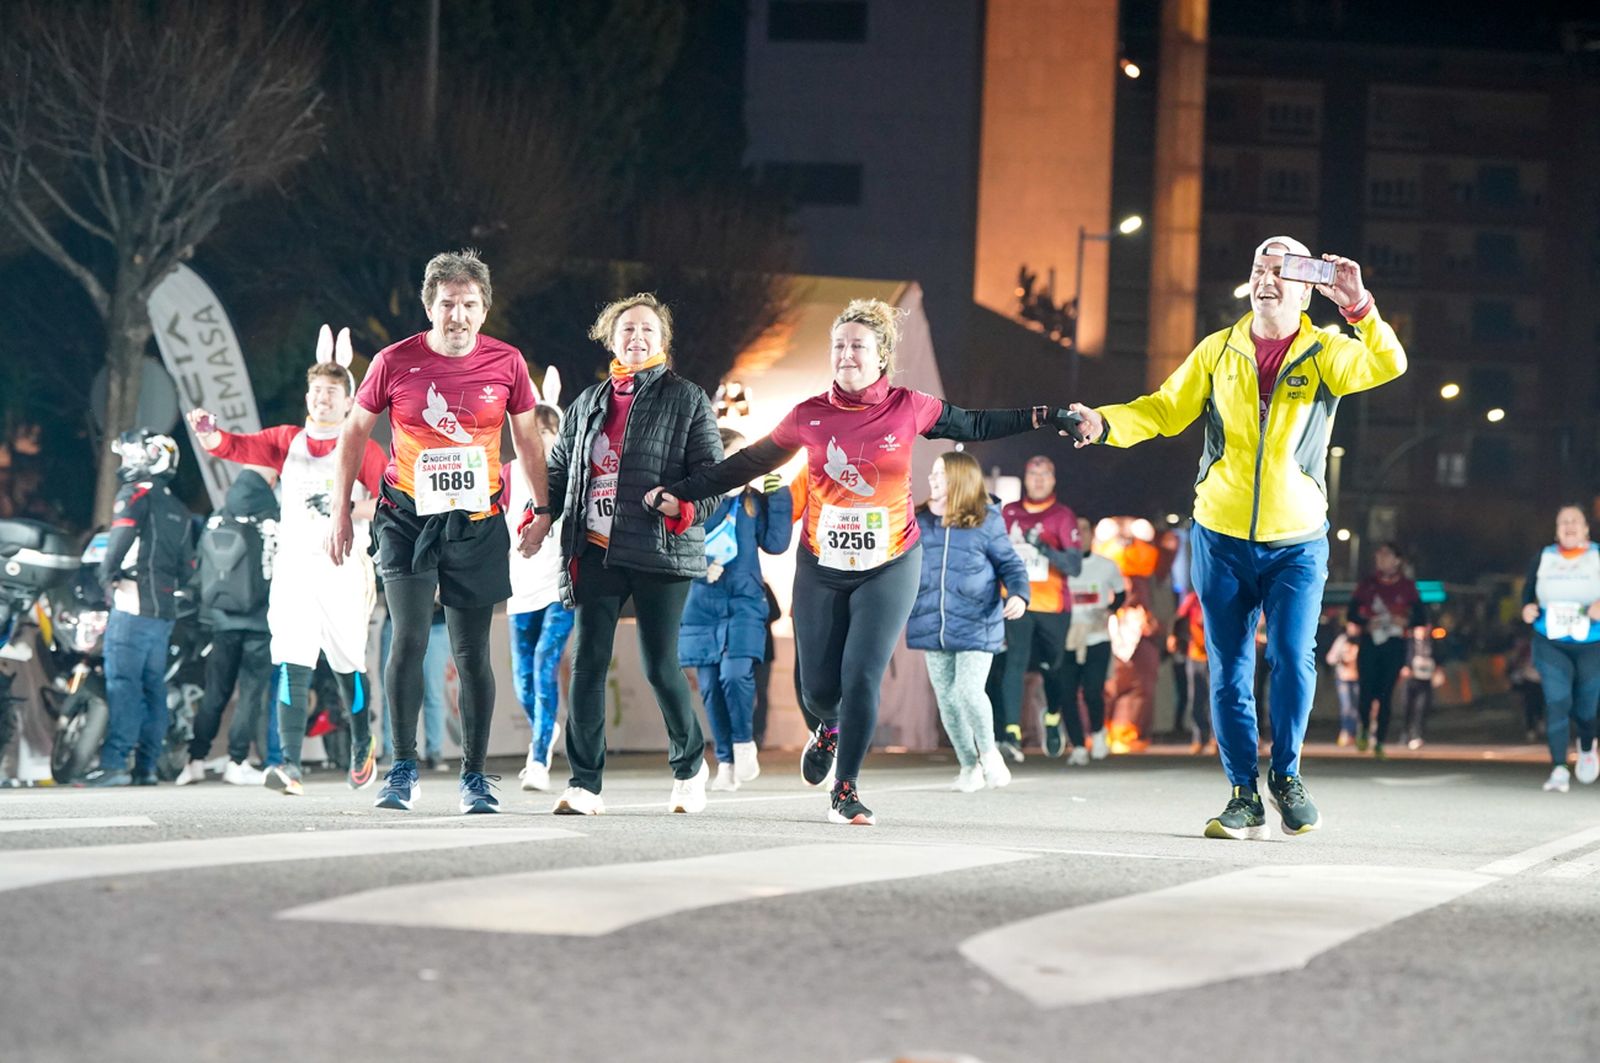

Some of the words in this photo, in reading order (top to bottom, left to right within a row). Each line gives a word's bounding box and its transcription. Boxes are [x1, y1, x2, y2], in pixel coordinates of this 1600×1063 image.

[192, 303, 248, 433] EMASA
[166, 312, 231, 491] DCIA
[437, 416, 457, 434] 43
[422, 464, 437, 472] SAN
[430, 454, 452, 463] NOCHE
[452, 454, 461, 462] DE
[602, 455, 619, 473] 43
[428, 470, 475, 491] 1689
[839, 469, 859, 487] 43
[594, 497, 616, 518] 16
[827, 530, 876, 550] 3256
